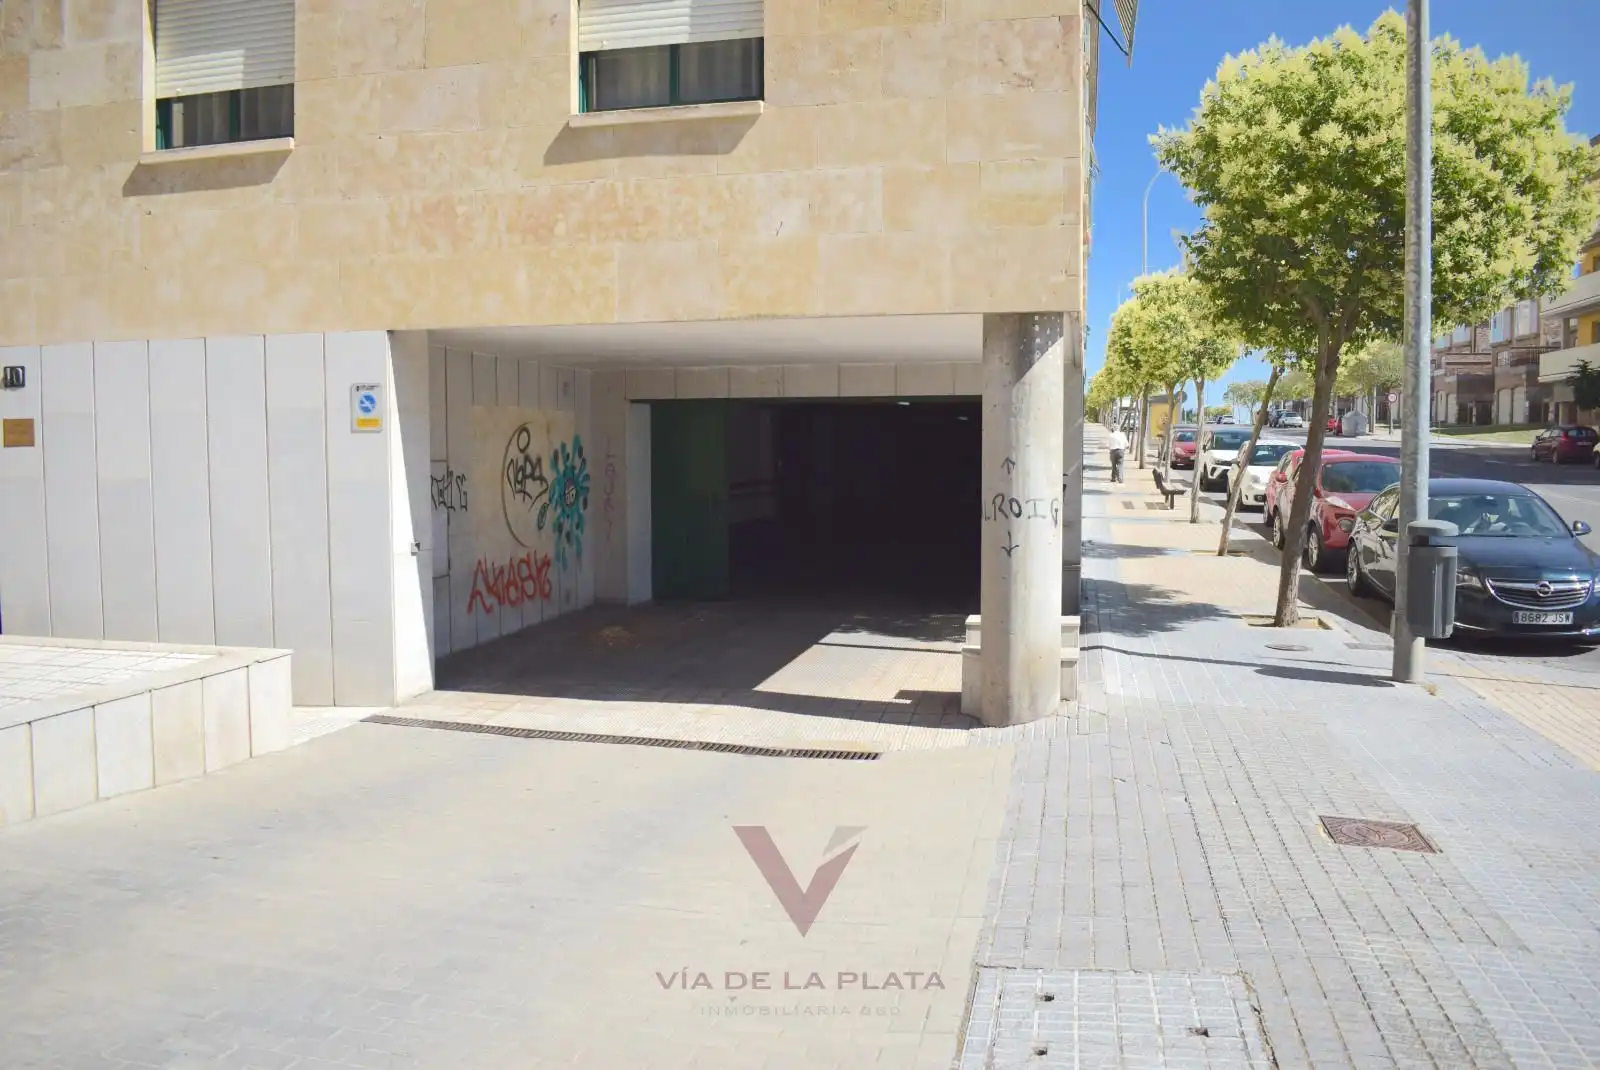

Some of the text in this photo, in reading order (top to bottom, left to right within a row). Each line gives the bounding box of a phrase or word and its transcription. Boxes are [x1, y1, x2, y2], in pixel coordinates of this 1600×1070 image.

[6, 367, 23, 385] 10
[1521, 613, 1570, 622] 8682 JSW
